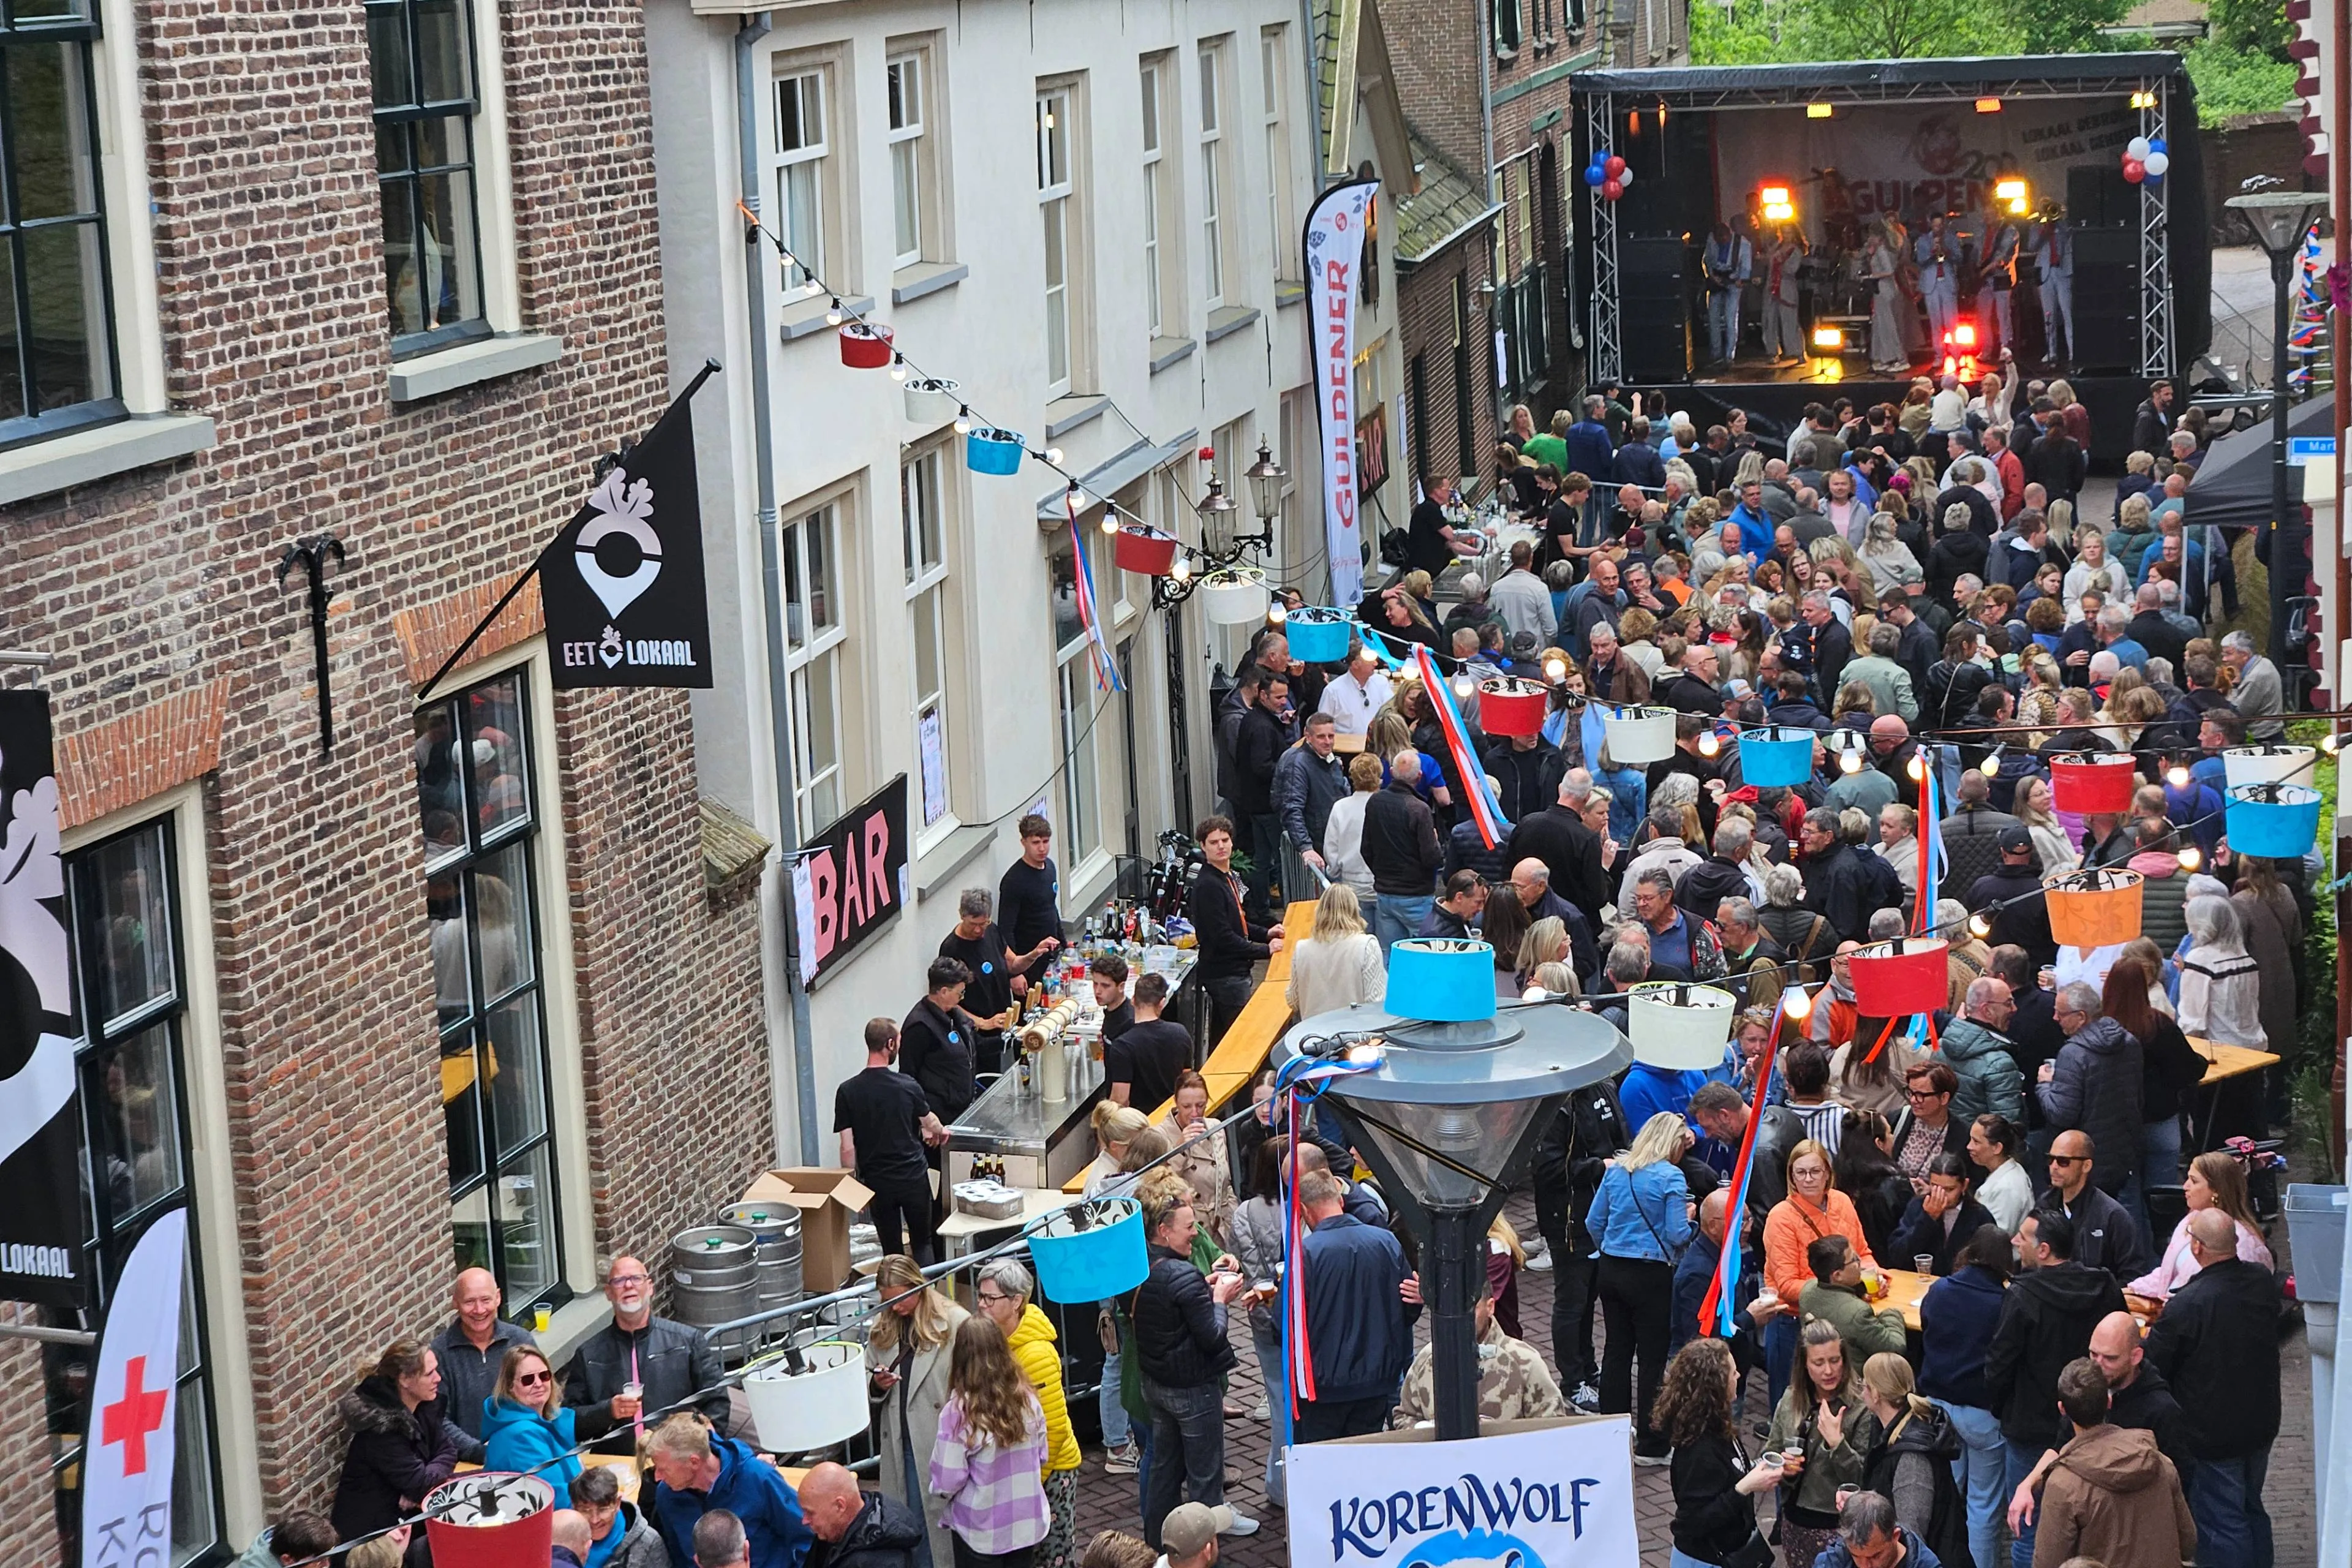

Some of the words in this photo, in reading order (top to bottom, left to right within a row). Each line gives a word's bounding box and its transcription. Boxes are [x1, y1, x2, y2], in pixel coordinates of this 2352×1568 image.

[563, 642, 597, 666] EET
[626, 640, 697, 666] LOKAAL
[810, 809, 891, 962] BAR
[1, 1242, 75, 1278] LOKAAL
